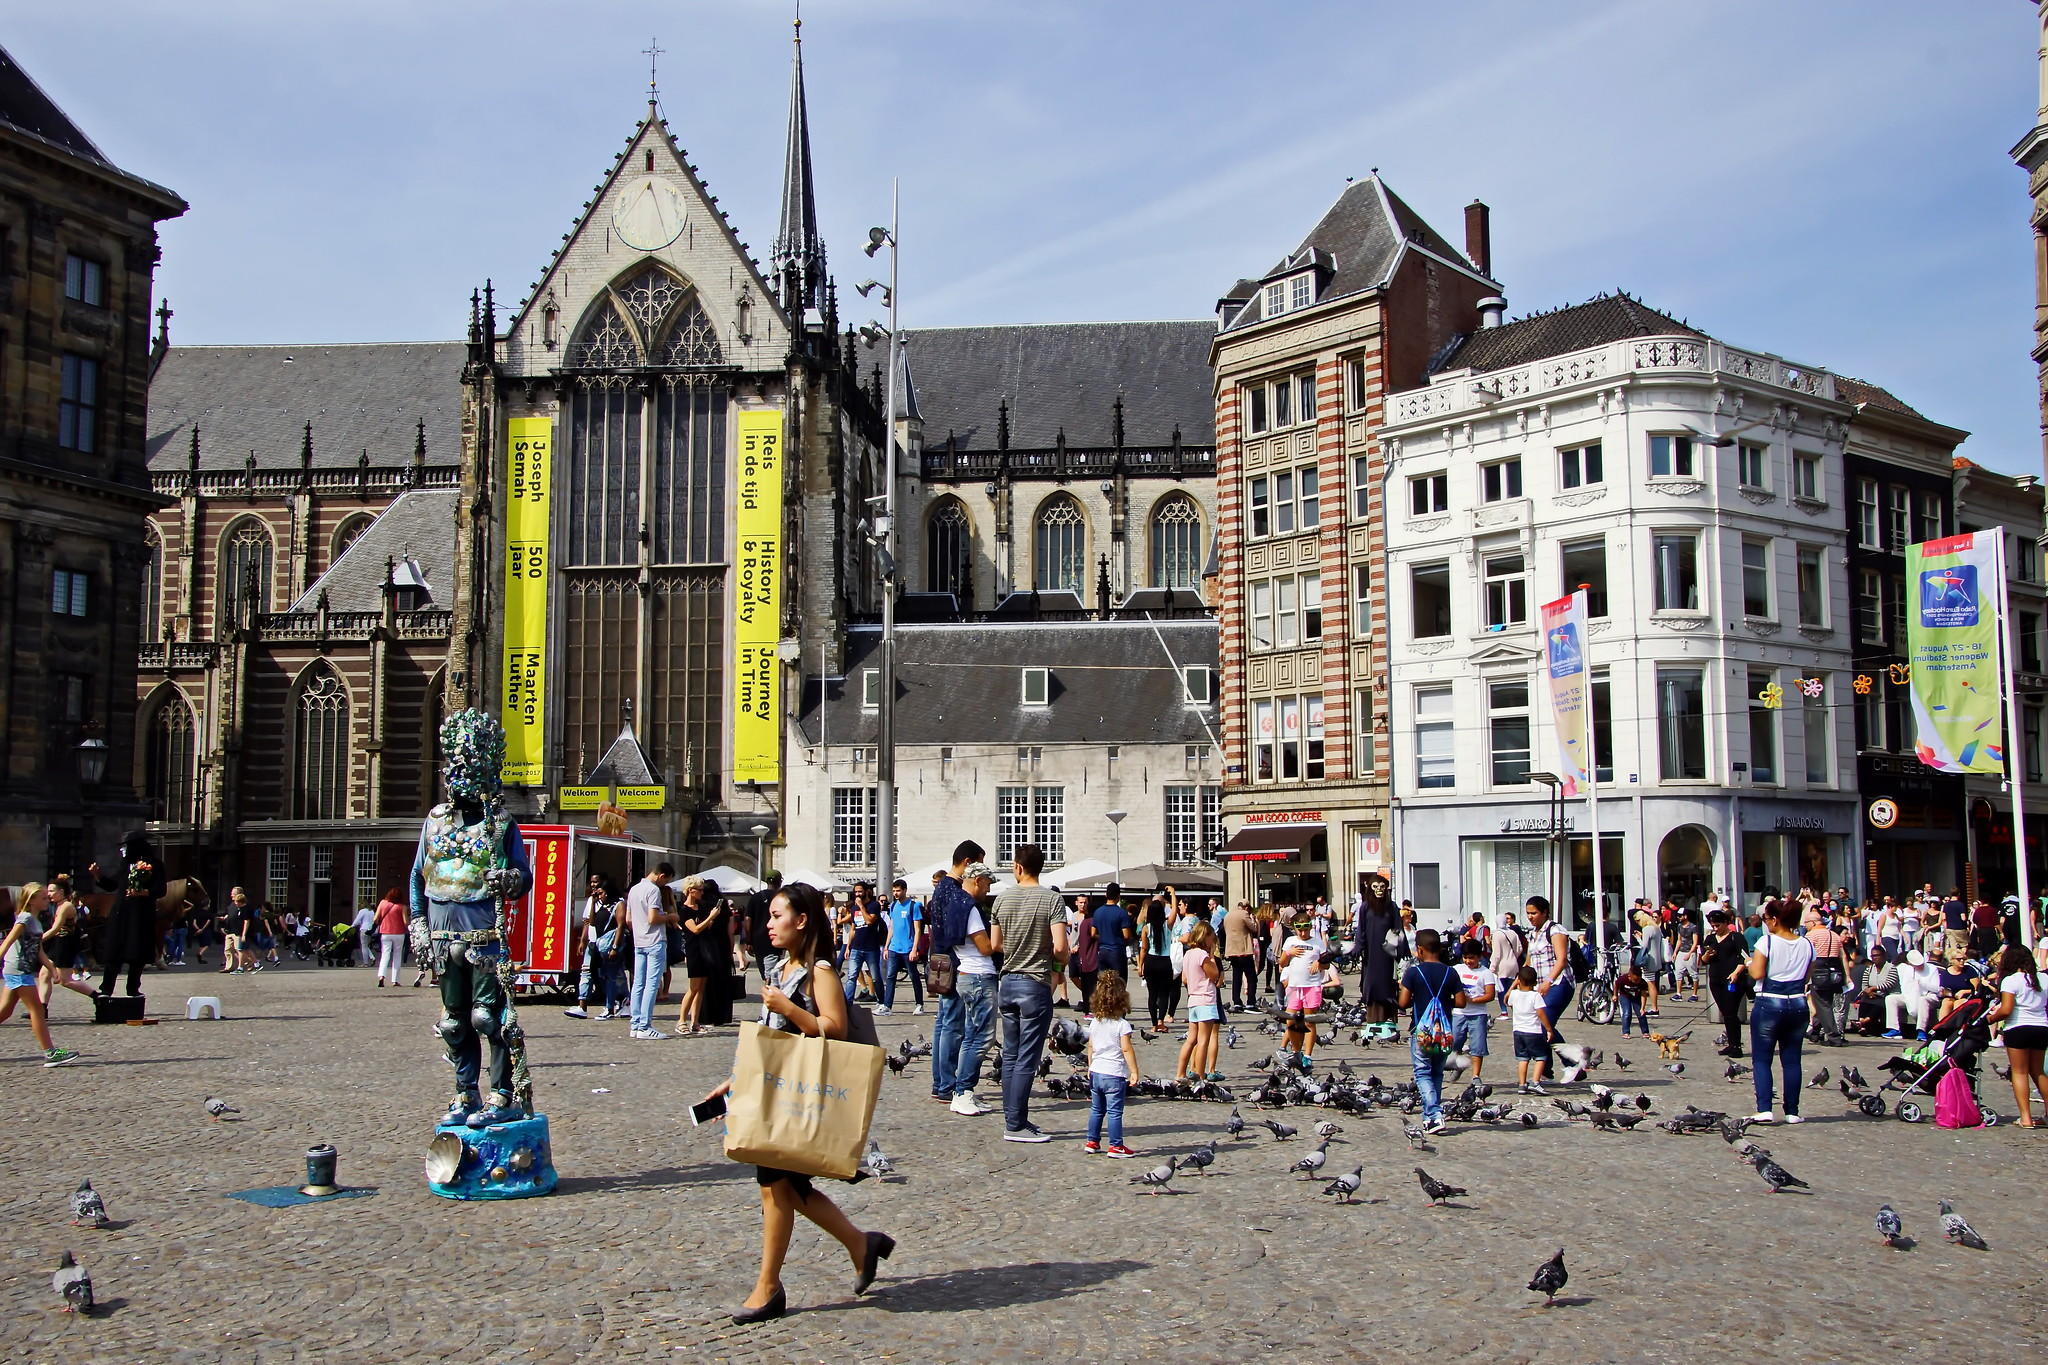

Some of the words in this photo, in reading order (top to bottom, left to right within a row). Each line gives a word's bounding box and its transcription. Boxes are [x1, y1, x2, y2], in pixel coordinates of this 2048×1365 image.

[745, 435, 759, 451] in
[762, 435, 776, 469] Reis
[513, 441, 528, 498] Semah
[529, 441, 546, 502] Joseph
[744, 456, 758, 476] de
[742, 480, 757, 510] tijd
[510, 546, 524, 579] jaar
[529, 547, 542, 578] 500
[743, 541, 755, 552] &
[759, 541, 775, 605] History
[740, 558, 756, 624] Royalty
[742, 648, 755, 664] in
[508, 654, 523, 711] Luther
[525, 653, 540, 726] Maarten
[741, 669, 755, 712] Time
[756, 648, 774, 721] Journey
[563, 788, 599, 797] Welkom
[619, 788, 660, 797] Welcome
[1246, 813, 1264, 823] DAM
[1265, 813, 1289, 822] GOOD
[1291, 811, 1323, 821] COFFEE
[1786, 816, 1825, 829] SWAROVSKI
[547, 841, 557, 886] COLD
[543, 891, 557, 961] DRINKS
[764, 1072, 849, 1100] PRIMARK
